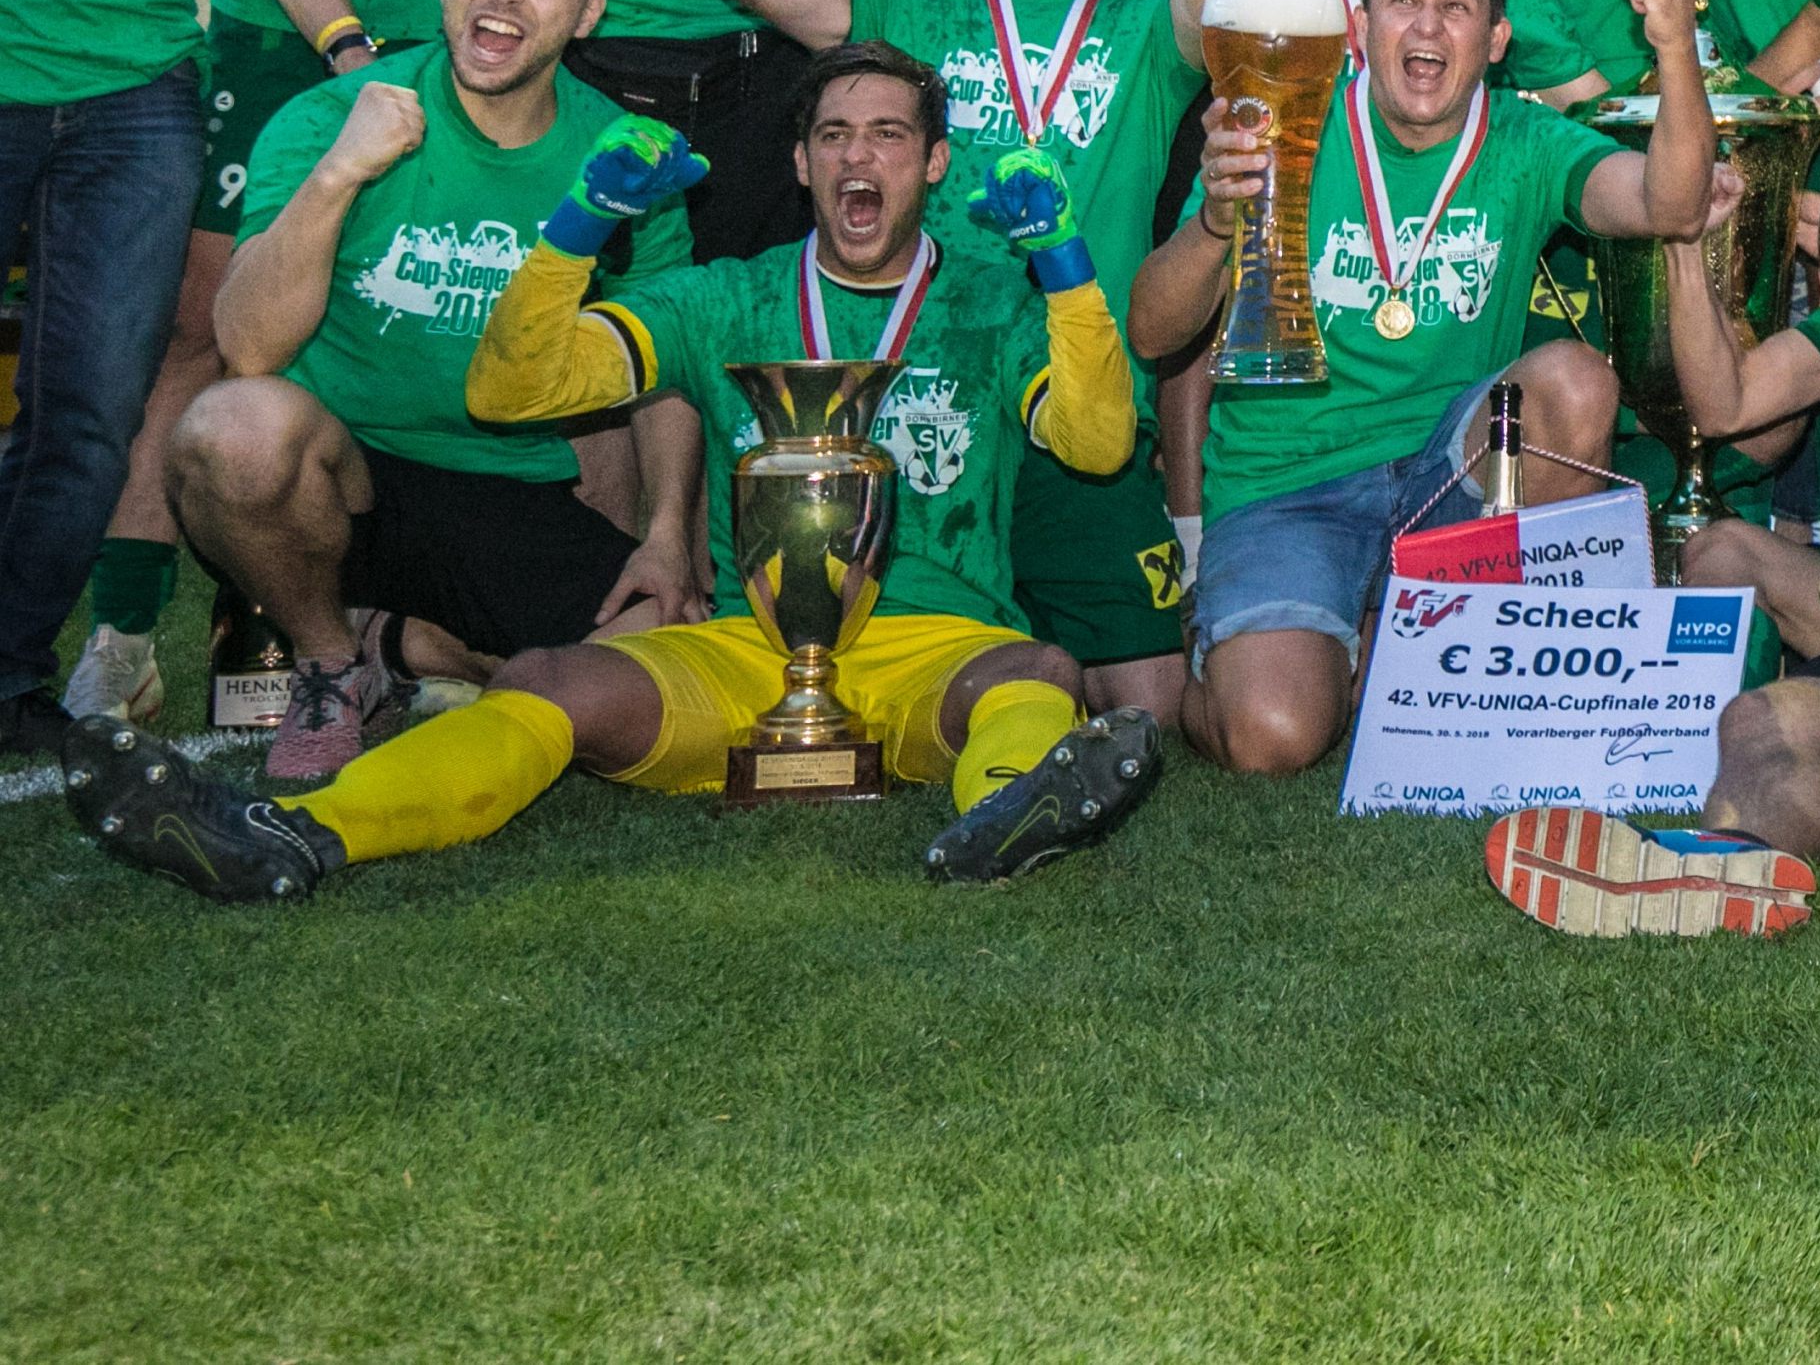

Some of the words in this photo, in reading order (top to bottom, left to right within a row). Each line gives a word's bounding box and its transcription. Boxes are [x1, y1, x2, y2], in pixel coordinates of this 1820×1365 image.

[1231, 96, 1270, 116] ERDINGER
[219, 162, 248, 209] 9
[1461, 259, 1494, 286] SV
[1362, 284, 1443, 326] 218
[919, 427, 956, 453] SV
[1424, 567, 1454, 584] 42.
[1459, 536, 1625, 579] VFV-UNIQA-Cup
[1495, 599, 1641, 630] Scheck
[1675, 622, 1732, 637] HYPO
[1674, 638, 1730, 648] VORARLBERG
[1439, 644, 1470, 677] €
[1484, 646, 1680, 684] 3.000,--
[1387, 689, 1419, 708] 42.
[1426, 691, 1659, 714] VFV-UNIQA-Cupfinale
[1665, 694, 1716, 710] 2018
[1382, 725, 1434, 737] Hohenems,
[1437, 729, 1453, 738] 30.
[1466, 730, 1490, 739] 2018
[1506, 727, 1596, 740] Vorarlberger
[1600, 726, 1710, 739] Fußballverband
[1402, 785, 1465, 802] UNIQA
[1519, 785, 1582, 802] UNIQA
[1635, 783, 1698, 800] UNIQA
